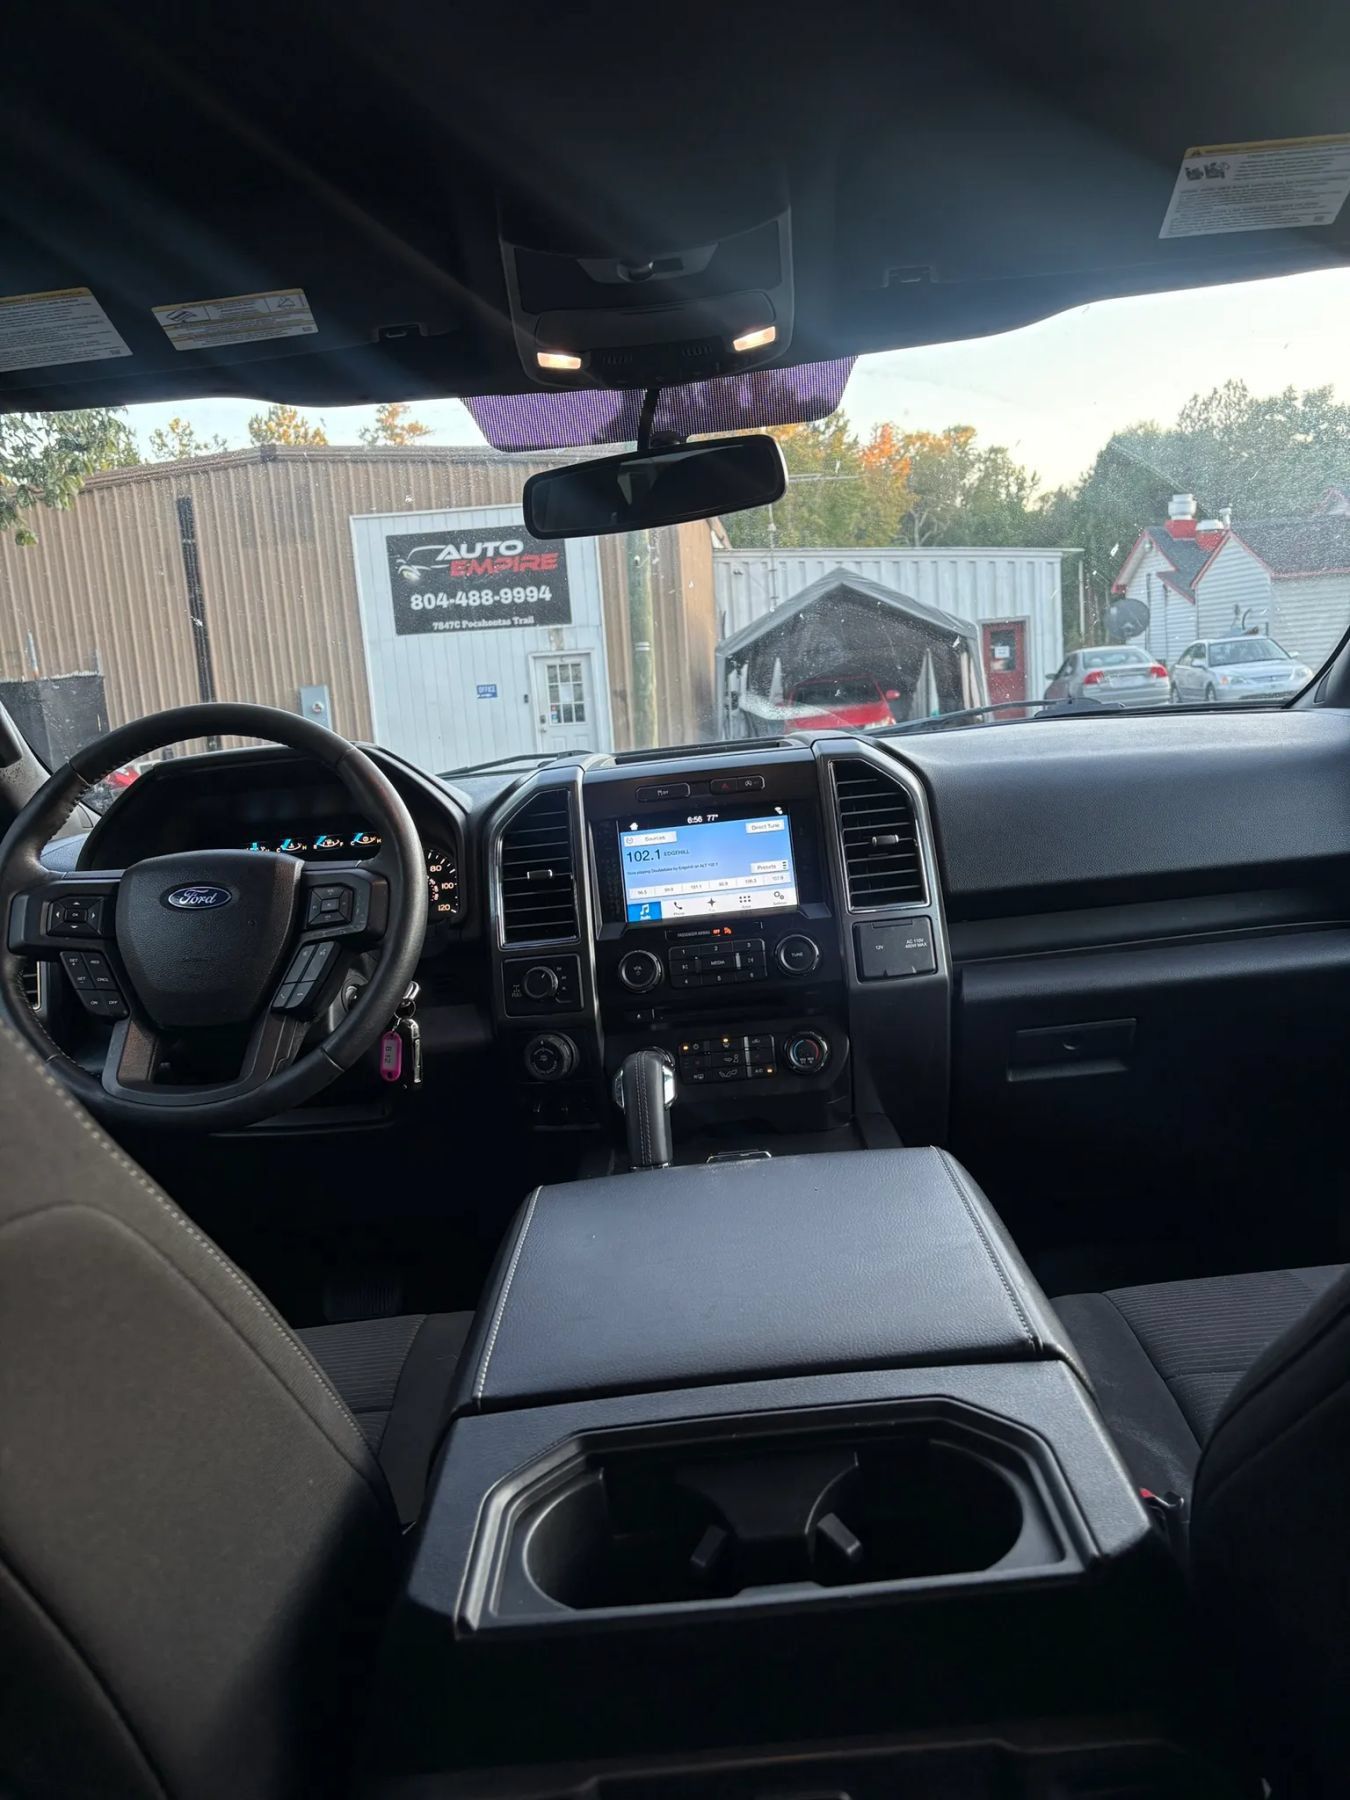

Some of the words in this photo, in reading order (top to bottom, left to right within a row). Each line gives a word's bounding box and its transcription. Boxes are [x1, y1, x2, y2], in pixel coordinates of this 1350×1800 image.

[435, 540, 524, 561] AUTO
[450, 552, 558, 577] EMPIRE
[410, 585, 552, 610] 804-488-9994
[461, 618, 511, 629] Pocahontas
[512, 616, 535, 625] Trail
[687, 816, 703, 824] 6:56
[626, 849, 661, 862] 102.1
[441, 882, 454, 890] 100
[179, 889, 218, 905] Ford
